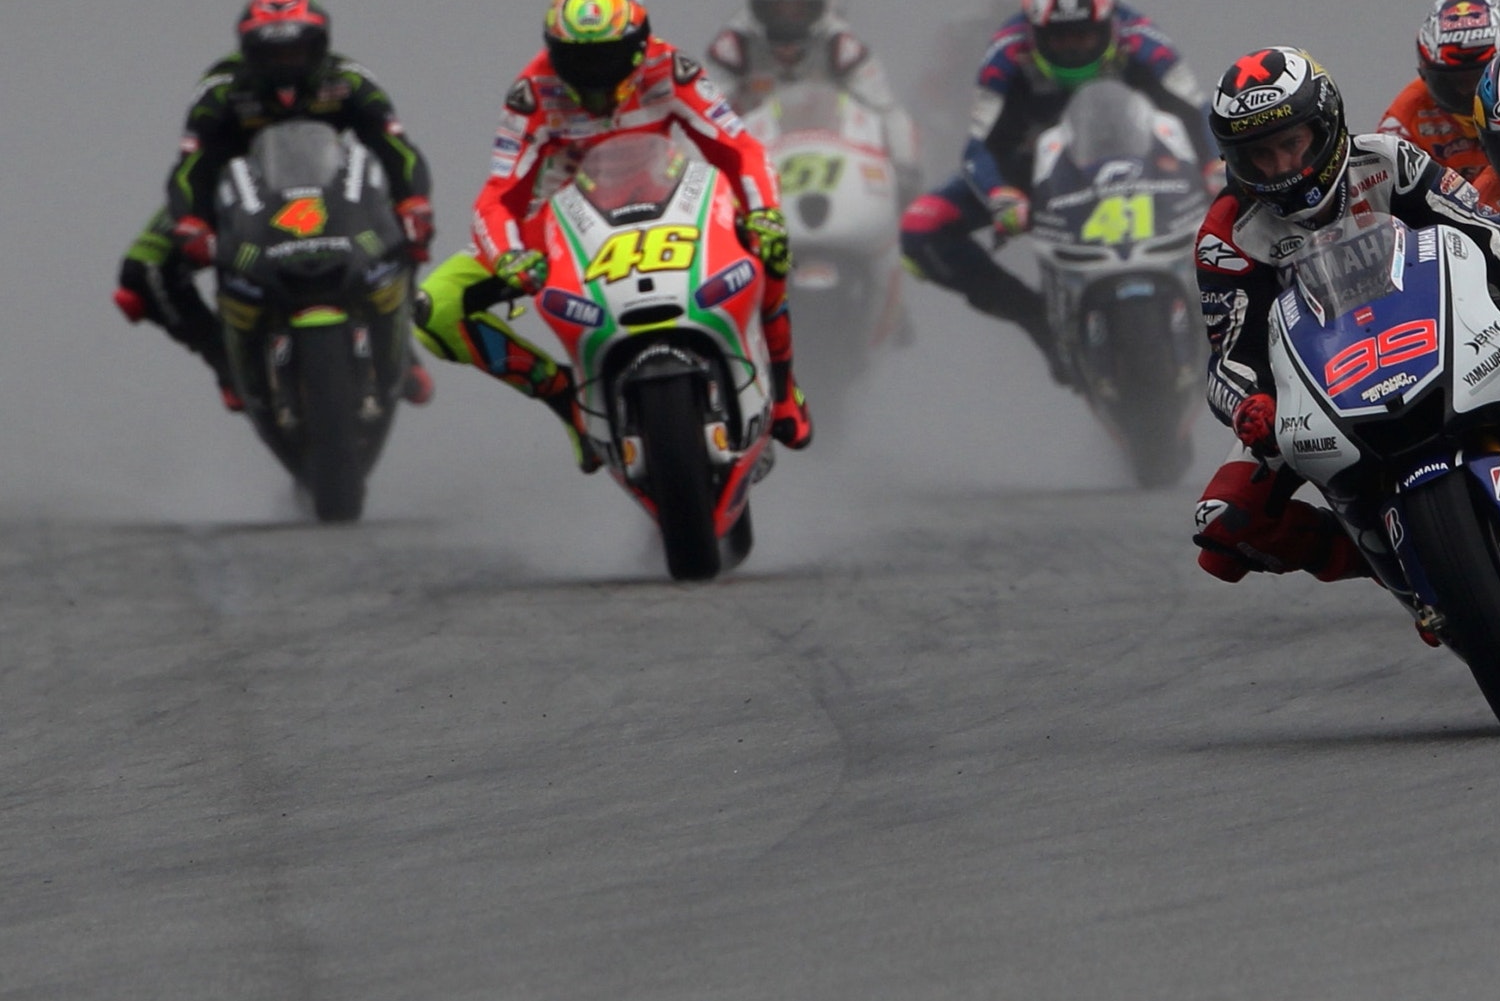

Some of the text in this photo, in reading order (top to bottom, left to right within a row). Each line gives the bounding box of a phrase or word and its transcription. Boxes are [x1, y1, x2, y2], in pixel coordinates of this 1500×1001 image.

[1438, 26, 1500, 45] NOLAN
[1357, 169, 1389, 192] YAMAHA
[1081, 193, 1155, 244] 41
[584, 224, 702, 285] 46
[1417, 227, 1438, 264] YAMAHA
[722, 262, 753, 293] TIM
[564, 298, 601, 327] TIM
[1279, 289, 1302, 331] YAMAHA
[1323, 318, 1439, 399] 99
[1293, 437, 1338, 453] YAMALUBE
[1403, 461, 1449, 488] YAMAHA
